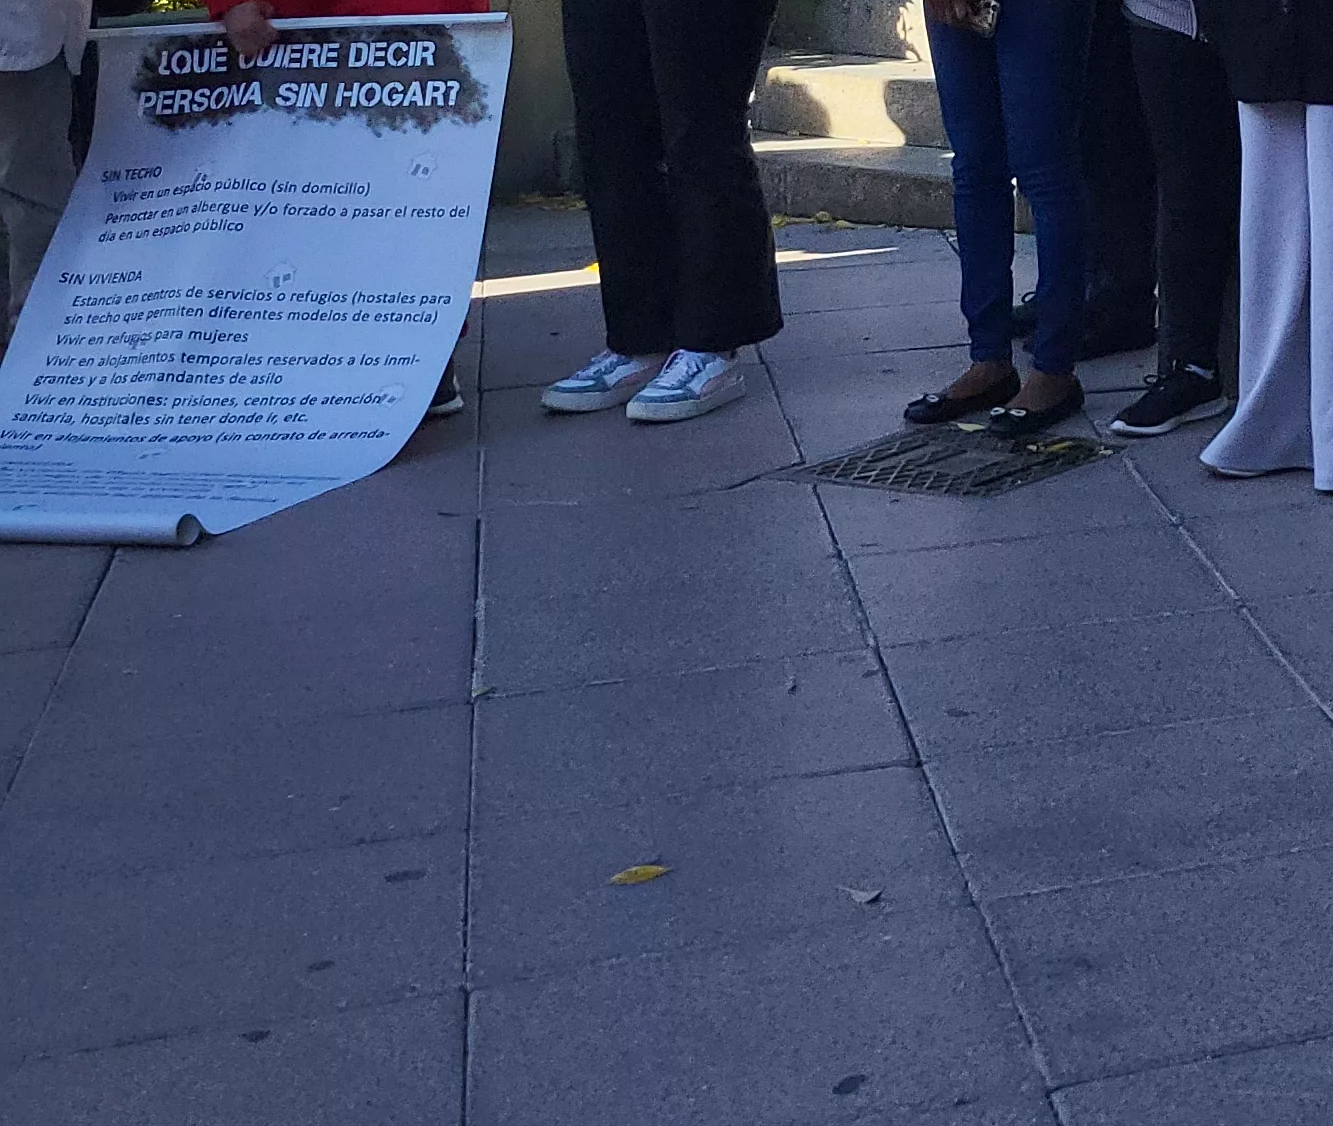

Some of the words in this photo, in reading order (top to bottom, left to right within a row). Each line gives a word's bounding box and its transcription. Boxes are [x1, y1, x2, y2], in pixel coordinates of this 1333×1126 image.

[158, 40, 228, 75] ¿QUÉ
[348, 40, 436, 68] DECIR
[139, 81, 262, 116] PERSONA
[275, 81, 328, 108] SIN
[334, 80, 461, 108] HOGAR?
[101, 169, 122, 182] SIN
[125, 166, 162, 181] TECHO
[113, 190, 137, 203] Vivir
[141, 190, 154, 200] en
[156, 188, 170, 198] un
[173, 179, 212, 196] espacio
[214, 178, 267, 193] público
[271, 179, 297, 194] (sin
[105, 209, 159, 224] Pernoctar
[161, 208, 174, 218] en
[176, 206, 189, 216] un
[191, 201, 249, 215] albergue
[253, 202, 278, 216] y/o
[283, 203, 336, 217] forzado
[340, 208, 348, 217] a
[352, 207, 391, 220] pasar
[394, 206, 407, 218] el
[411, 206, 445, 218] resto
[449, 205, 471, 218] del
[119, 230, 132, 241] en
[136, 229, 150, 239] un
[152, 222, 190, 238] espacio
[193, 219, 244, 234] público
[58, 272, 85, 285] SIN
[88, 270, 143, 285] VIVIENDA
[72, 294, 122, 307] Estancia
[125, 294, 139, 304] en
[142, 287, 182, 302] centros
[185, 286, 203, 298] de
[207, 287, 273, 302] servicios
[276, 292, 286, 302] o
[290, 290, 348, 306] refugios
[351, 290, 416, 306] (hostales
[419, 294, 452, 306] para
[64, 313, 83, 325] sin
[86, 310, 120, 324] techo
[123, 310, 145, 325] que
[146, 306, 204, 322] permiten
[208, 306, 283, 321] diferentes
[287, 309, 348, 322] modelos
[352, 309, 370, 322] de
[374, 309, 438, 325] estancia)
[55, 334, 87, 346] Vivir
[88, 335, 104, 345] en
[154, 330, 183, 342] para
[188, 330, 249, 344] mujeres
[46, 355, 77, 368] Vivir
[78, 357, 95, 367] en
[98, 352, 175, 369] alojamientos
[180, 352, 263, 368] temporales
[267, 354, 343, 366] reservados
[348, 357, 356, 366] a
[360, 354, 380, 366] los
[33, 374, 84, 388] grantes
[87, 375, 97, 388] y
[99, 375, 107, 385] a
[110, 372, 128, 385] los
[130, 371, 224, 385] demandantes
[229, 372, 247, 385] de
[250, 373, 283, 385] asilo
[24, 394, 55, 406] Vivir
[58, 396, 76, 406] en
[78, 394, 168, 407] instituciones:
[172, 394, 239, 409] prisiones,
[244, 394, 296, 406] centros
[300, 394, 318, 406] de
[320, 392, 381, 406] atención
[12, 412, 76, 425] sanitaria,
[81, 412, 150, 428] hospitales
[153, 414, 175, 425] sin
[178, 414, 216, 425] tener
[218, 412, 264, 424] donde
[266, 412, 278, 425] ir,
[283, 412, 308, 424] etc.
[0, 429, 32, 440] Vivir
[34, 432, 53, 441] en
[55, 432, 145, 443] alojamientos
[148, 433, 167, 443] de
[169, 434, 213, 444] apoyo
[215, 431, 242, 444] (sin
[244, 430, 305, 442] contrato
[308, 430, 326, 441] de
[328, 428, 391, 441] arrenda-
